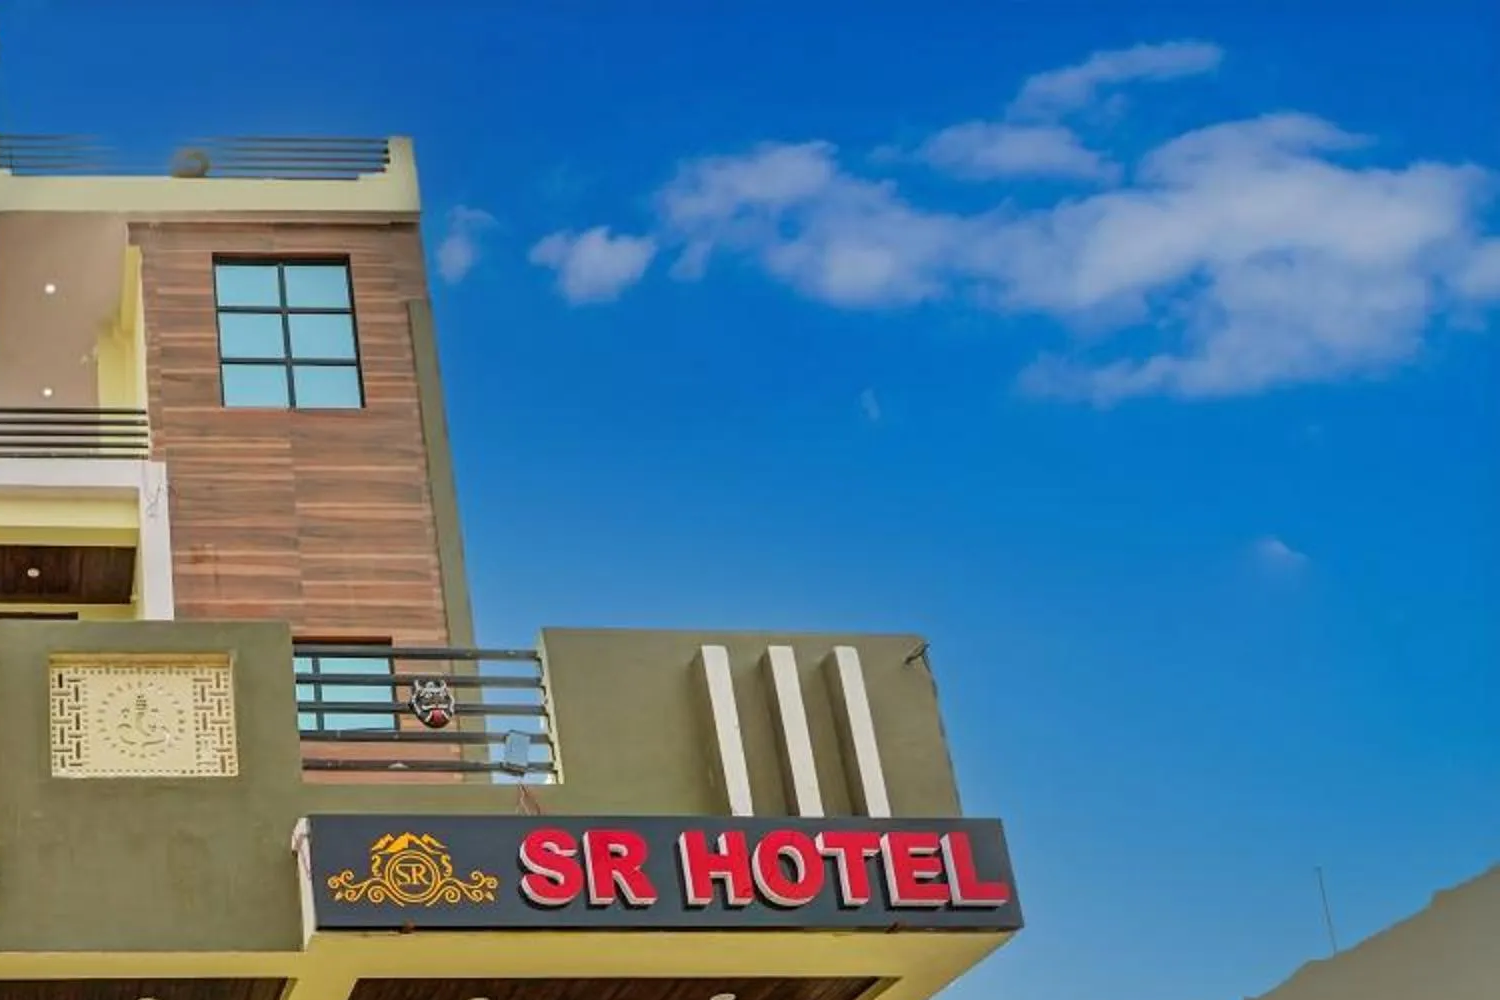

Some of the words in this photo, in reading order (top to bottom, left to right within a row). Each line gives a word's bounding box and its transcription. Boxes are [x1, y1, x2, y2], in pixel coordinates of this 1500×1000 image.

[396, 863, 430, 885] SR
[520, 826, 658, 905] SR
[678, 828, 1011, 907] HOTEL
